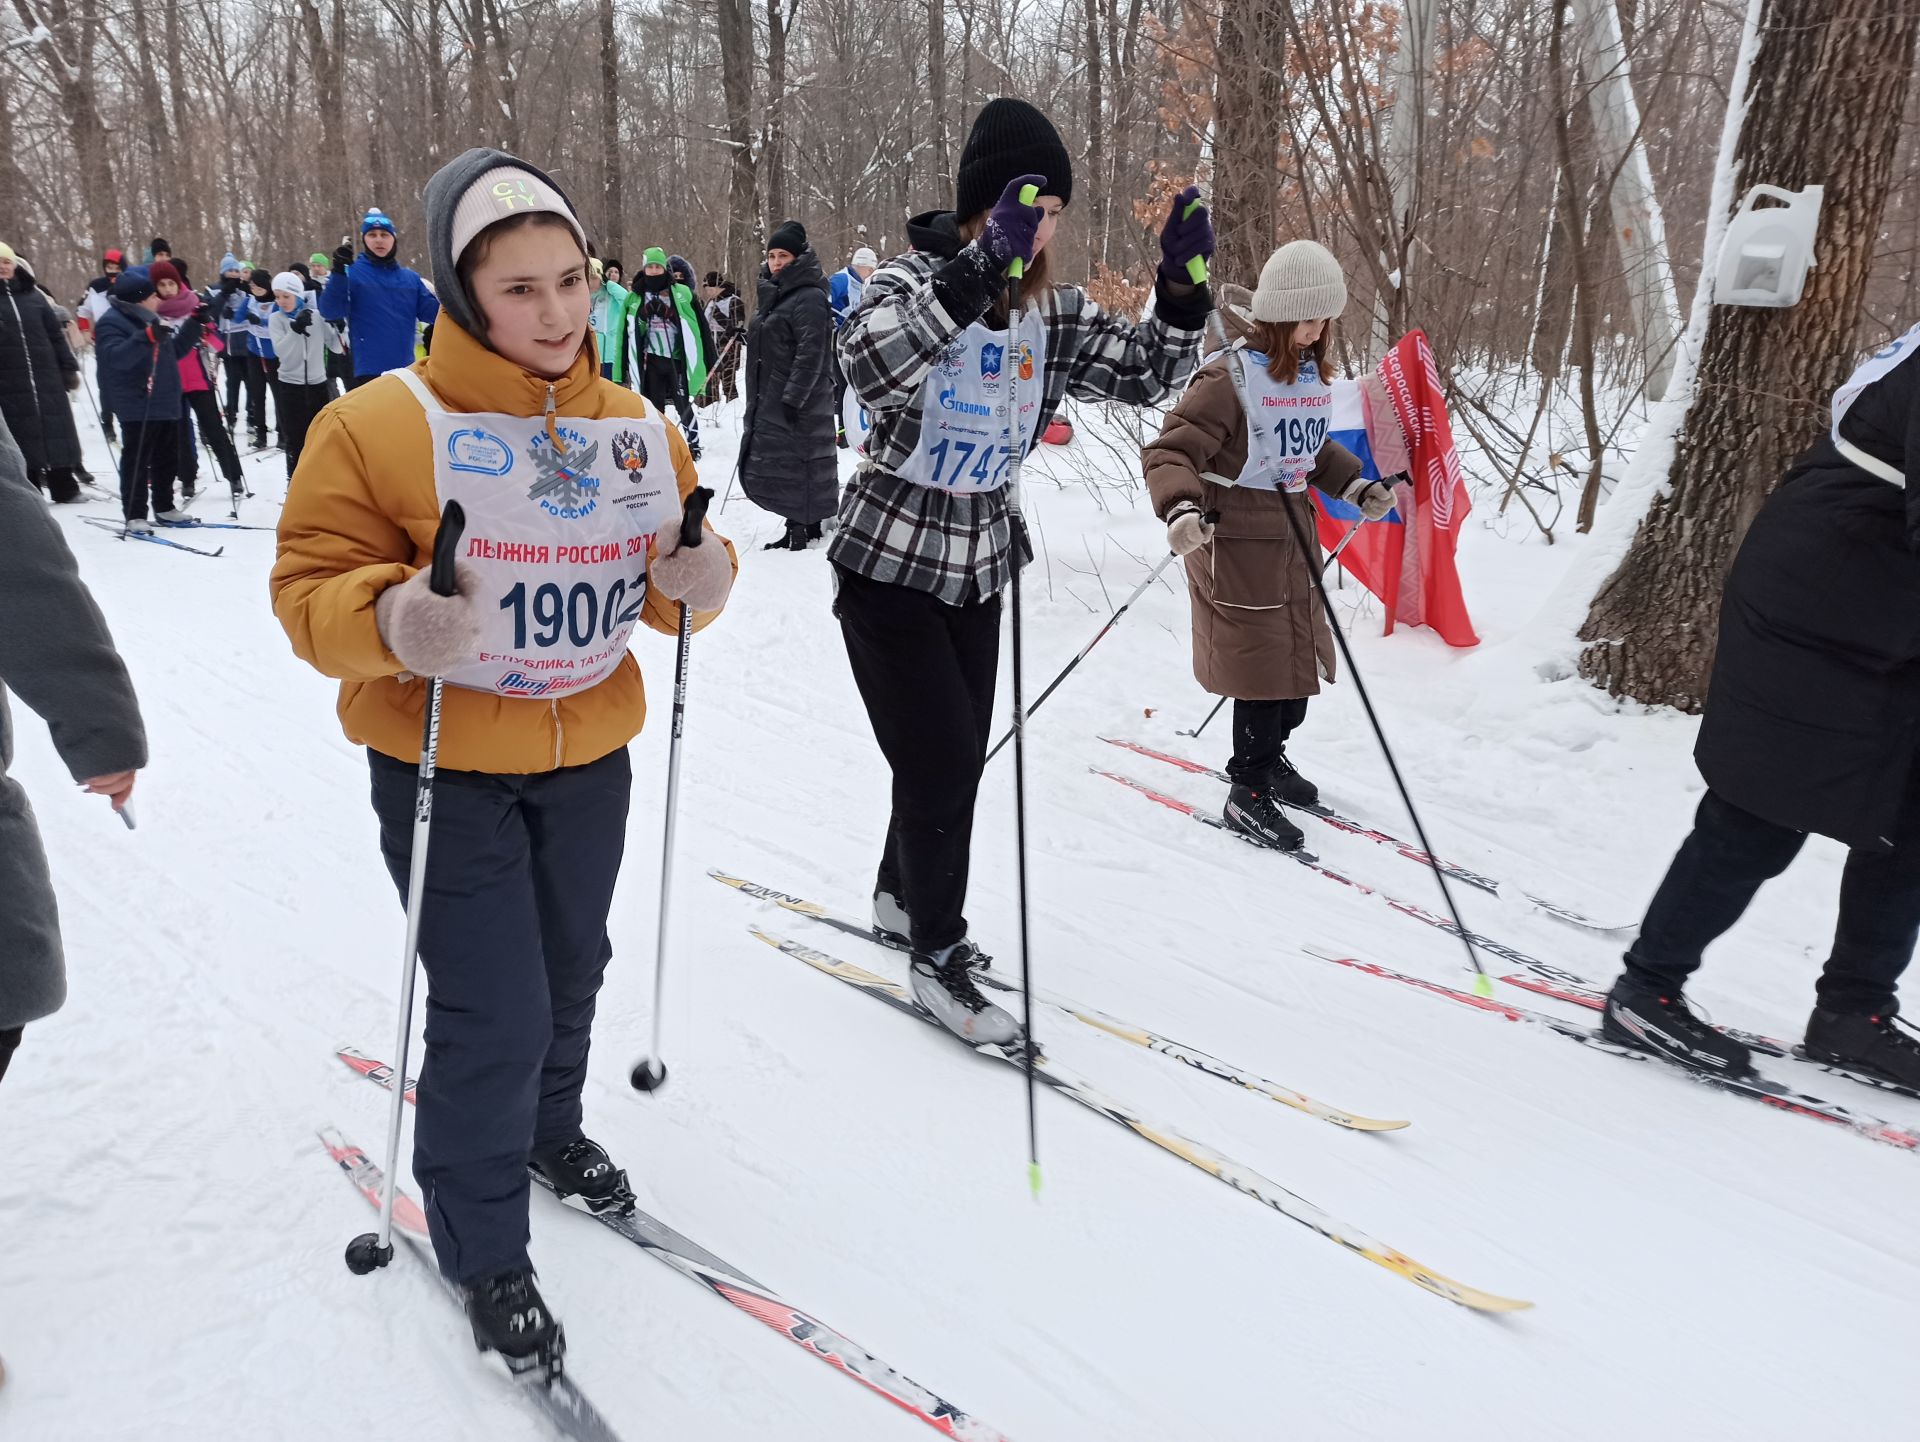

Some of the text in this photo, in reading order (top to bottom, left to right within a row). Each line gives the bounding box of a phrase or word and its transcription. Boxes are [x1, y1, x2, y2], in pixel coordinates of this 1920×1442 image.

[954, 400, 991, 417] ГАЗПРОМ
[1261, 396, 1298, 407] ЛЫЖНЯ
[612, 490, 662, 505] МИНСПОРТТУРИЗМ
[625, 501, 649, 510] РОССИИ
[539, 499, 597, 520] РОССИИ
[466, 537, 549, 564] ЛЫЖНЯ
[555, 542, 622, 565] РОССИИ
[479, 652, 575, 669] ЕСПУБЛИКА
[421, 674, 443, 779] OWLINE
